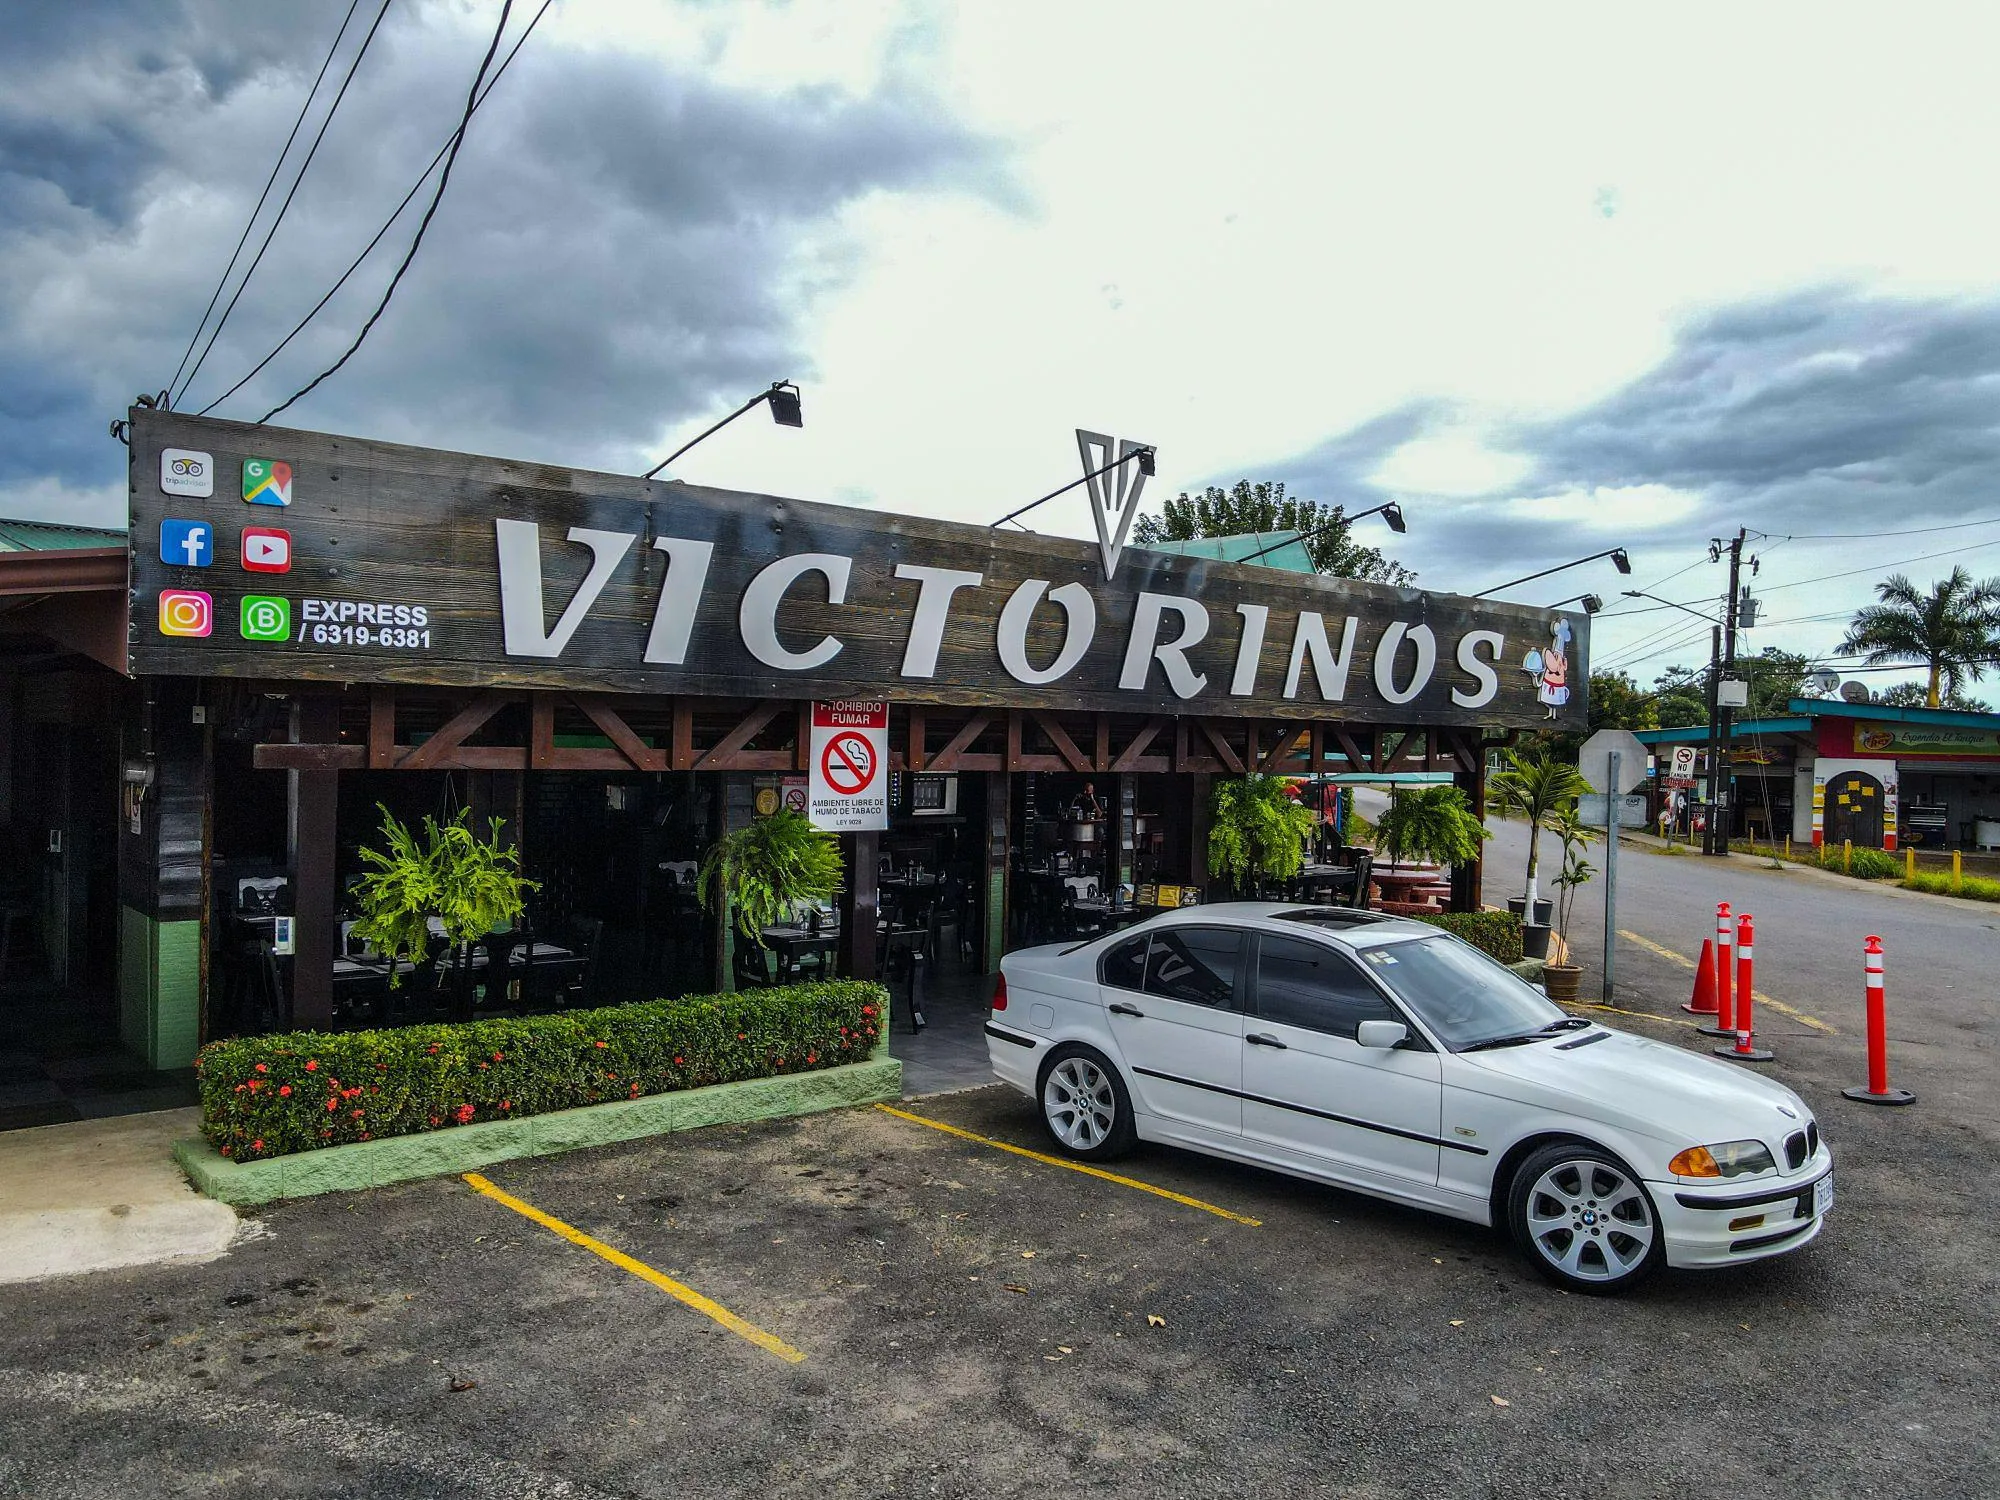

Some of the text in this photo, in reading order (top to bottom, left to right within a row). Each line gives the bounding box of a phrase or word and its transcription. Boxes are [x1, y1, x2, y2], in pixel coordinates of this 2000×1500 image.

[247, 462, 263, 477] G
[165, 476, 207, 488] tripadvisor
[182, 528, 206, 566] f
[258, 608, 276, 627] B
[302, 599, 428, 627] EXPRESS
[495, 518, 1505, 708] VICTORINOS
[313, 624, 430, 649] 6319-6381
[831, 713, 870, 725] FUMAR
[1901, 731, 1940, 743] Expendio
[1677, 763, 1687, 771] NO
[812, 798, 885, 807] AMBIENTE LIBRE DE
[815, 807, 882, 816] HUMO DE TABACO
